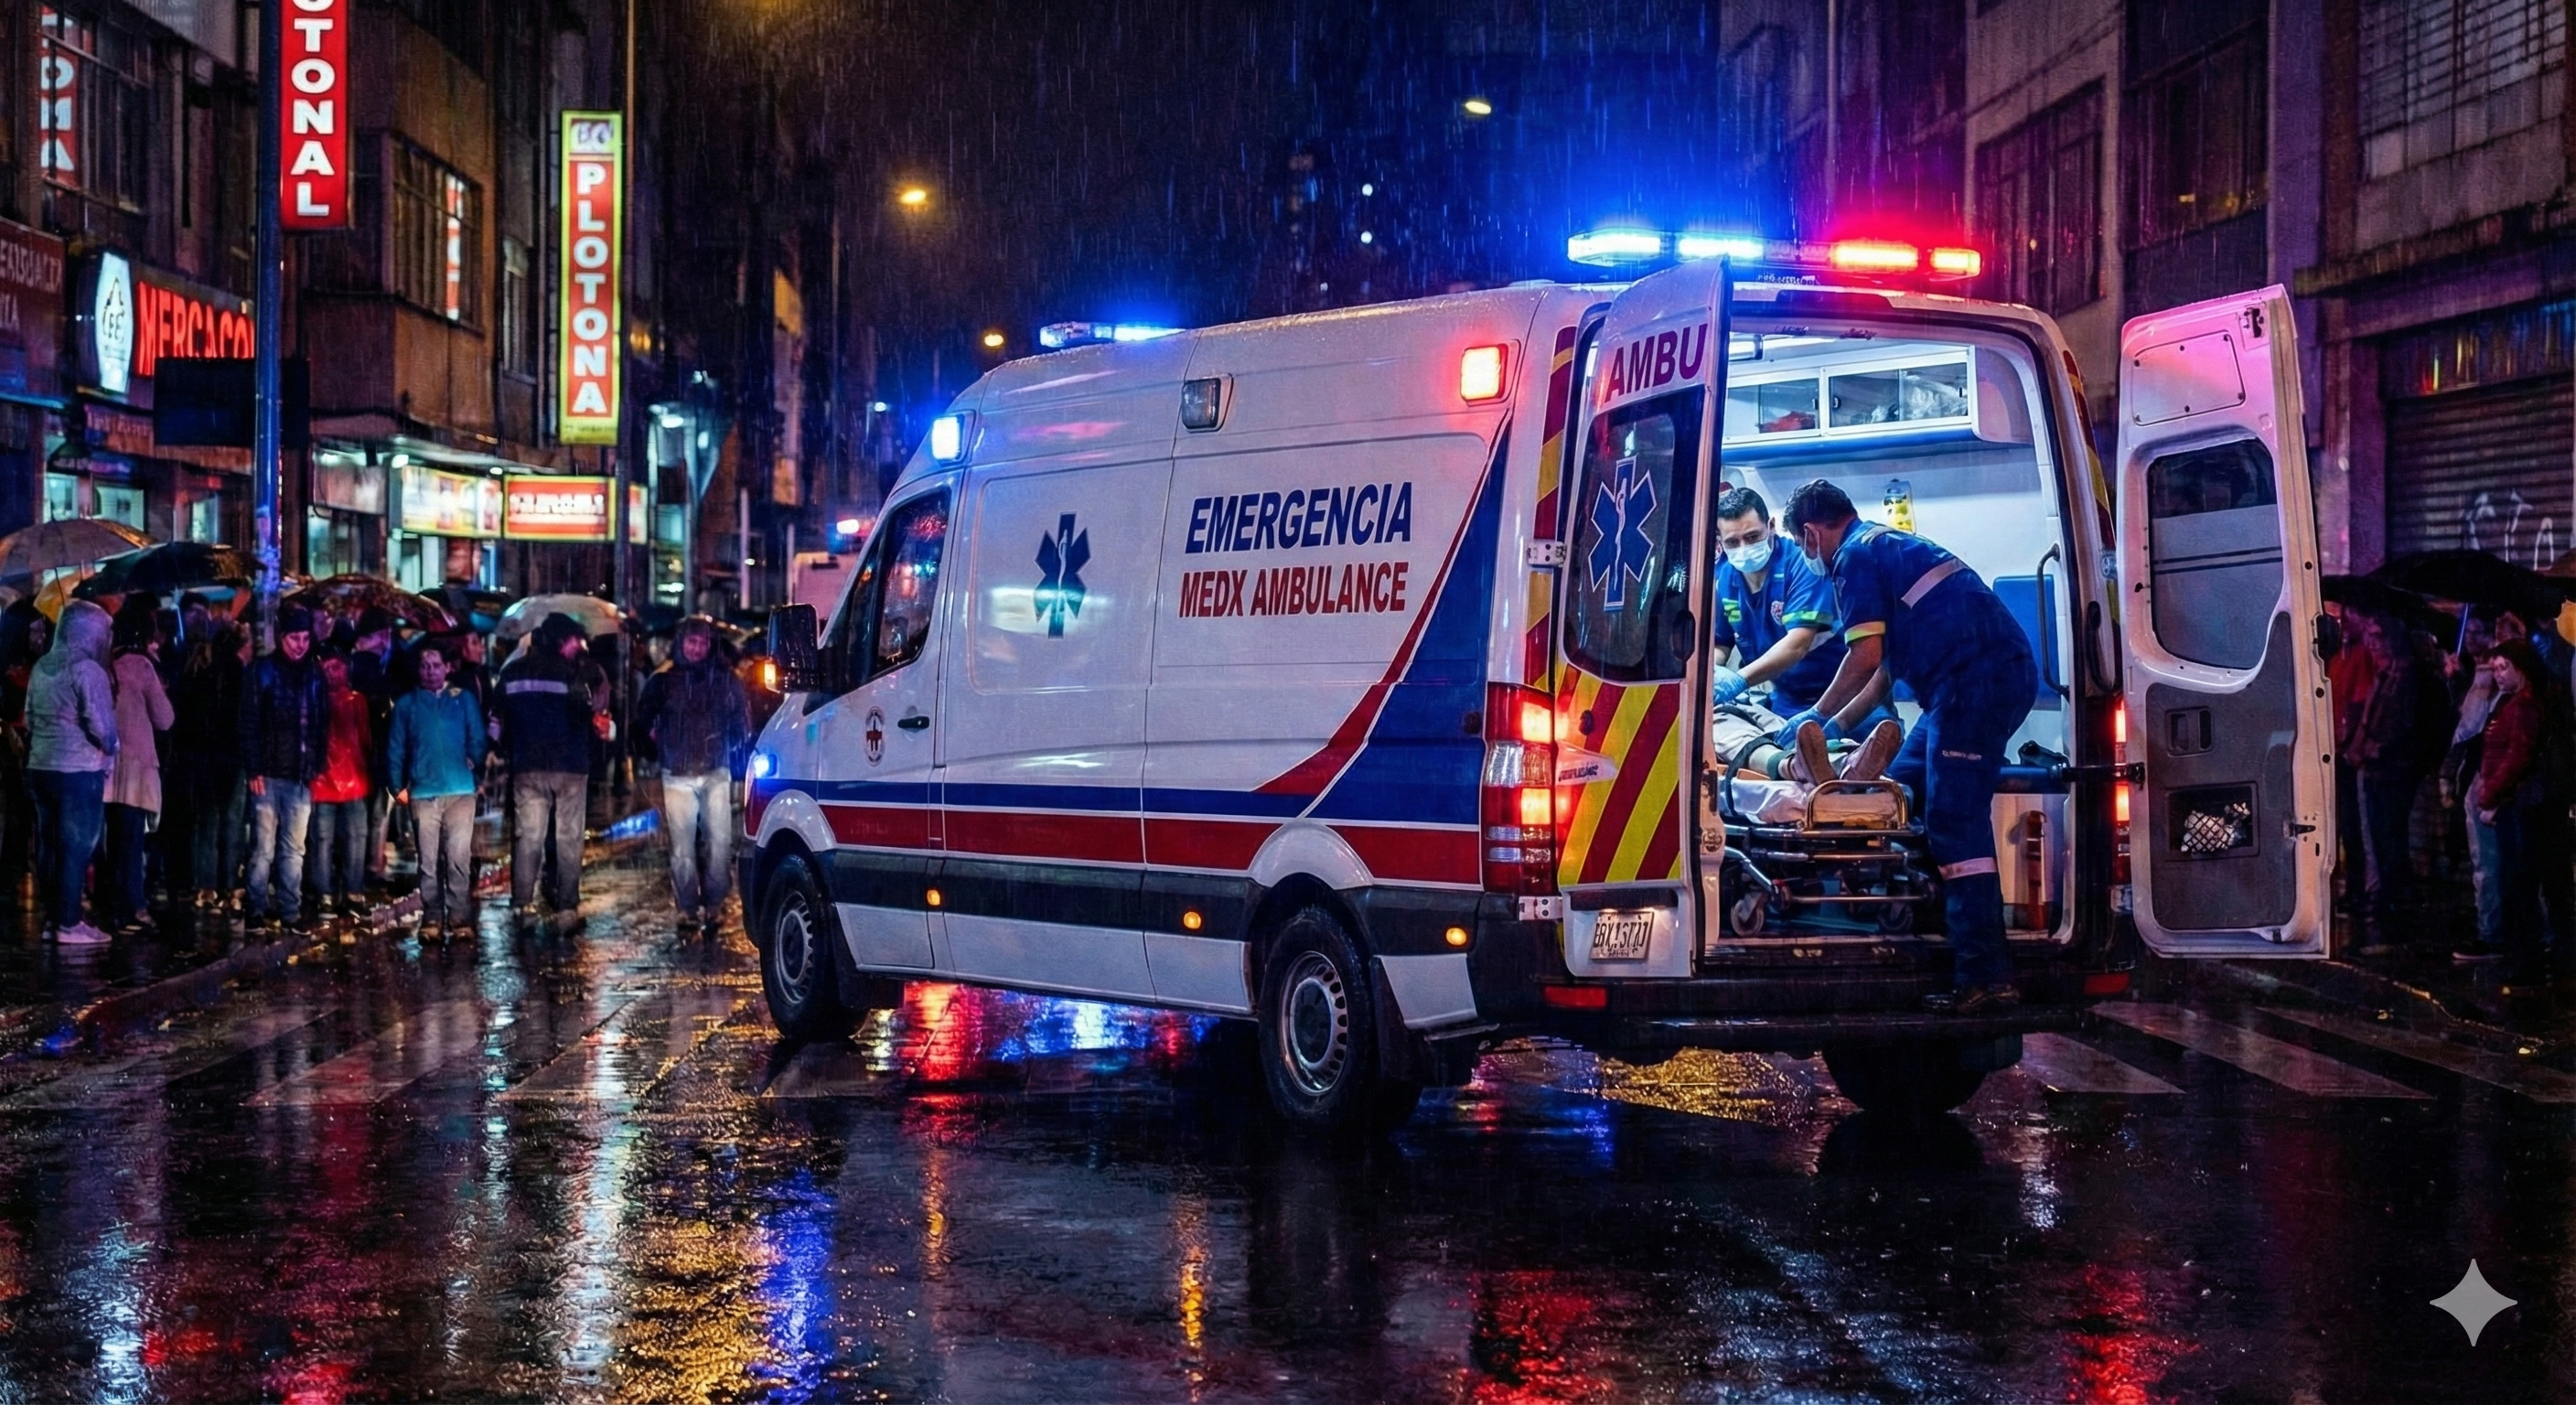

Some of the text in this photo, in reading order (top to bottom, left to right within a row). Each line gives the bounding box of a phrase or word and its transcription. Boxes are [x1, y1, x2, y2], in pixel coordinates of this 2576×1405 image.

[572, 162, 608, 413] PLOTONA
[140, 281, 254, 376] MERCACO
[1604, 323, 1708, 403] AMBU
[1185, 481, 1412, 554] EMERGENCIA
[1179, 561, 1409, 618] MEDX AMBULANCE
